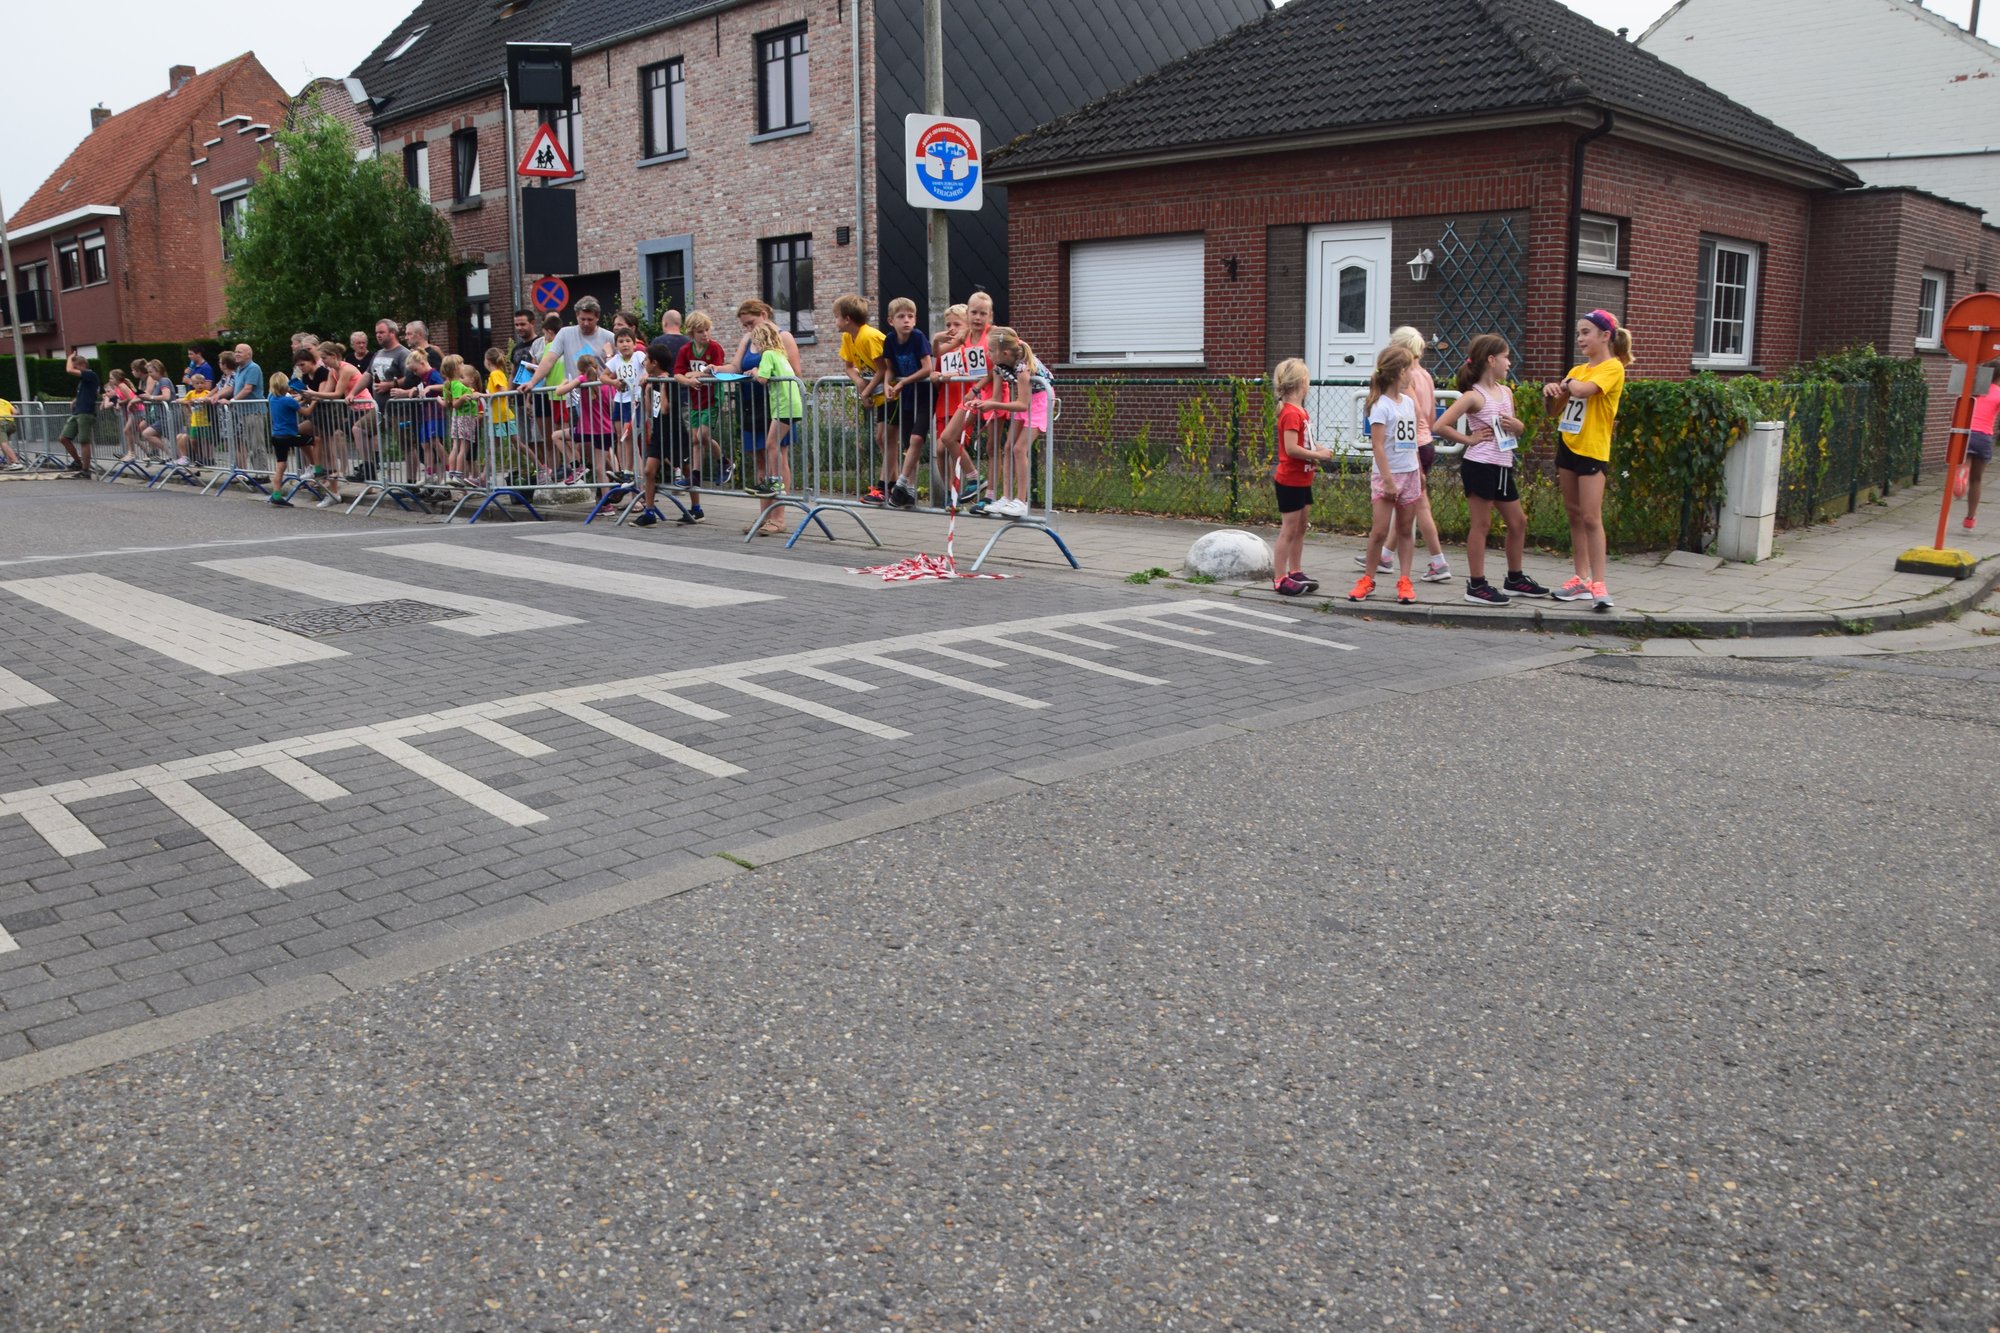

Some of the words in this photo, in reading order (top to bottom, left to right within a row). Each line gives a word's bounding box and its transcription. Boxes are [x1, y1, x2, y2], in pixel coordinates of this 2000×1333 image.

[943, 352, 963, 371] 142
[969, 350, 985, 368] 95
[1566, 400, 1584, 422] 72
[1396, 420, 1415, 441] 85
